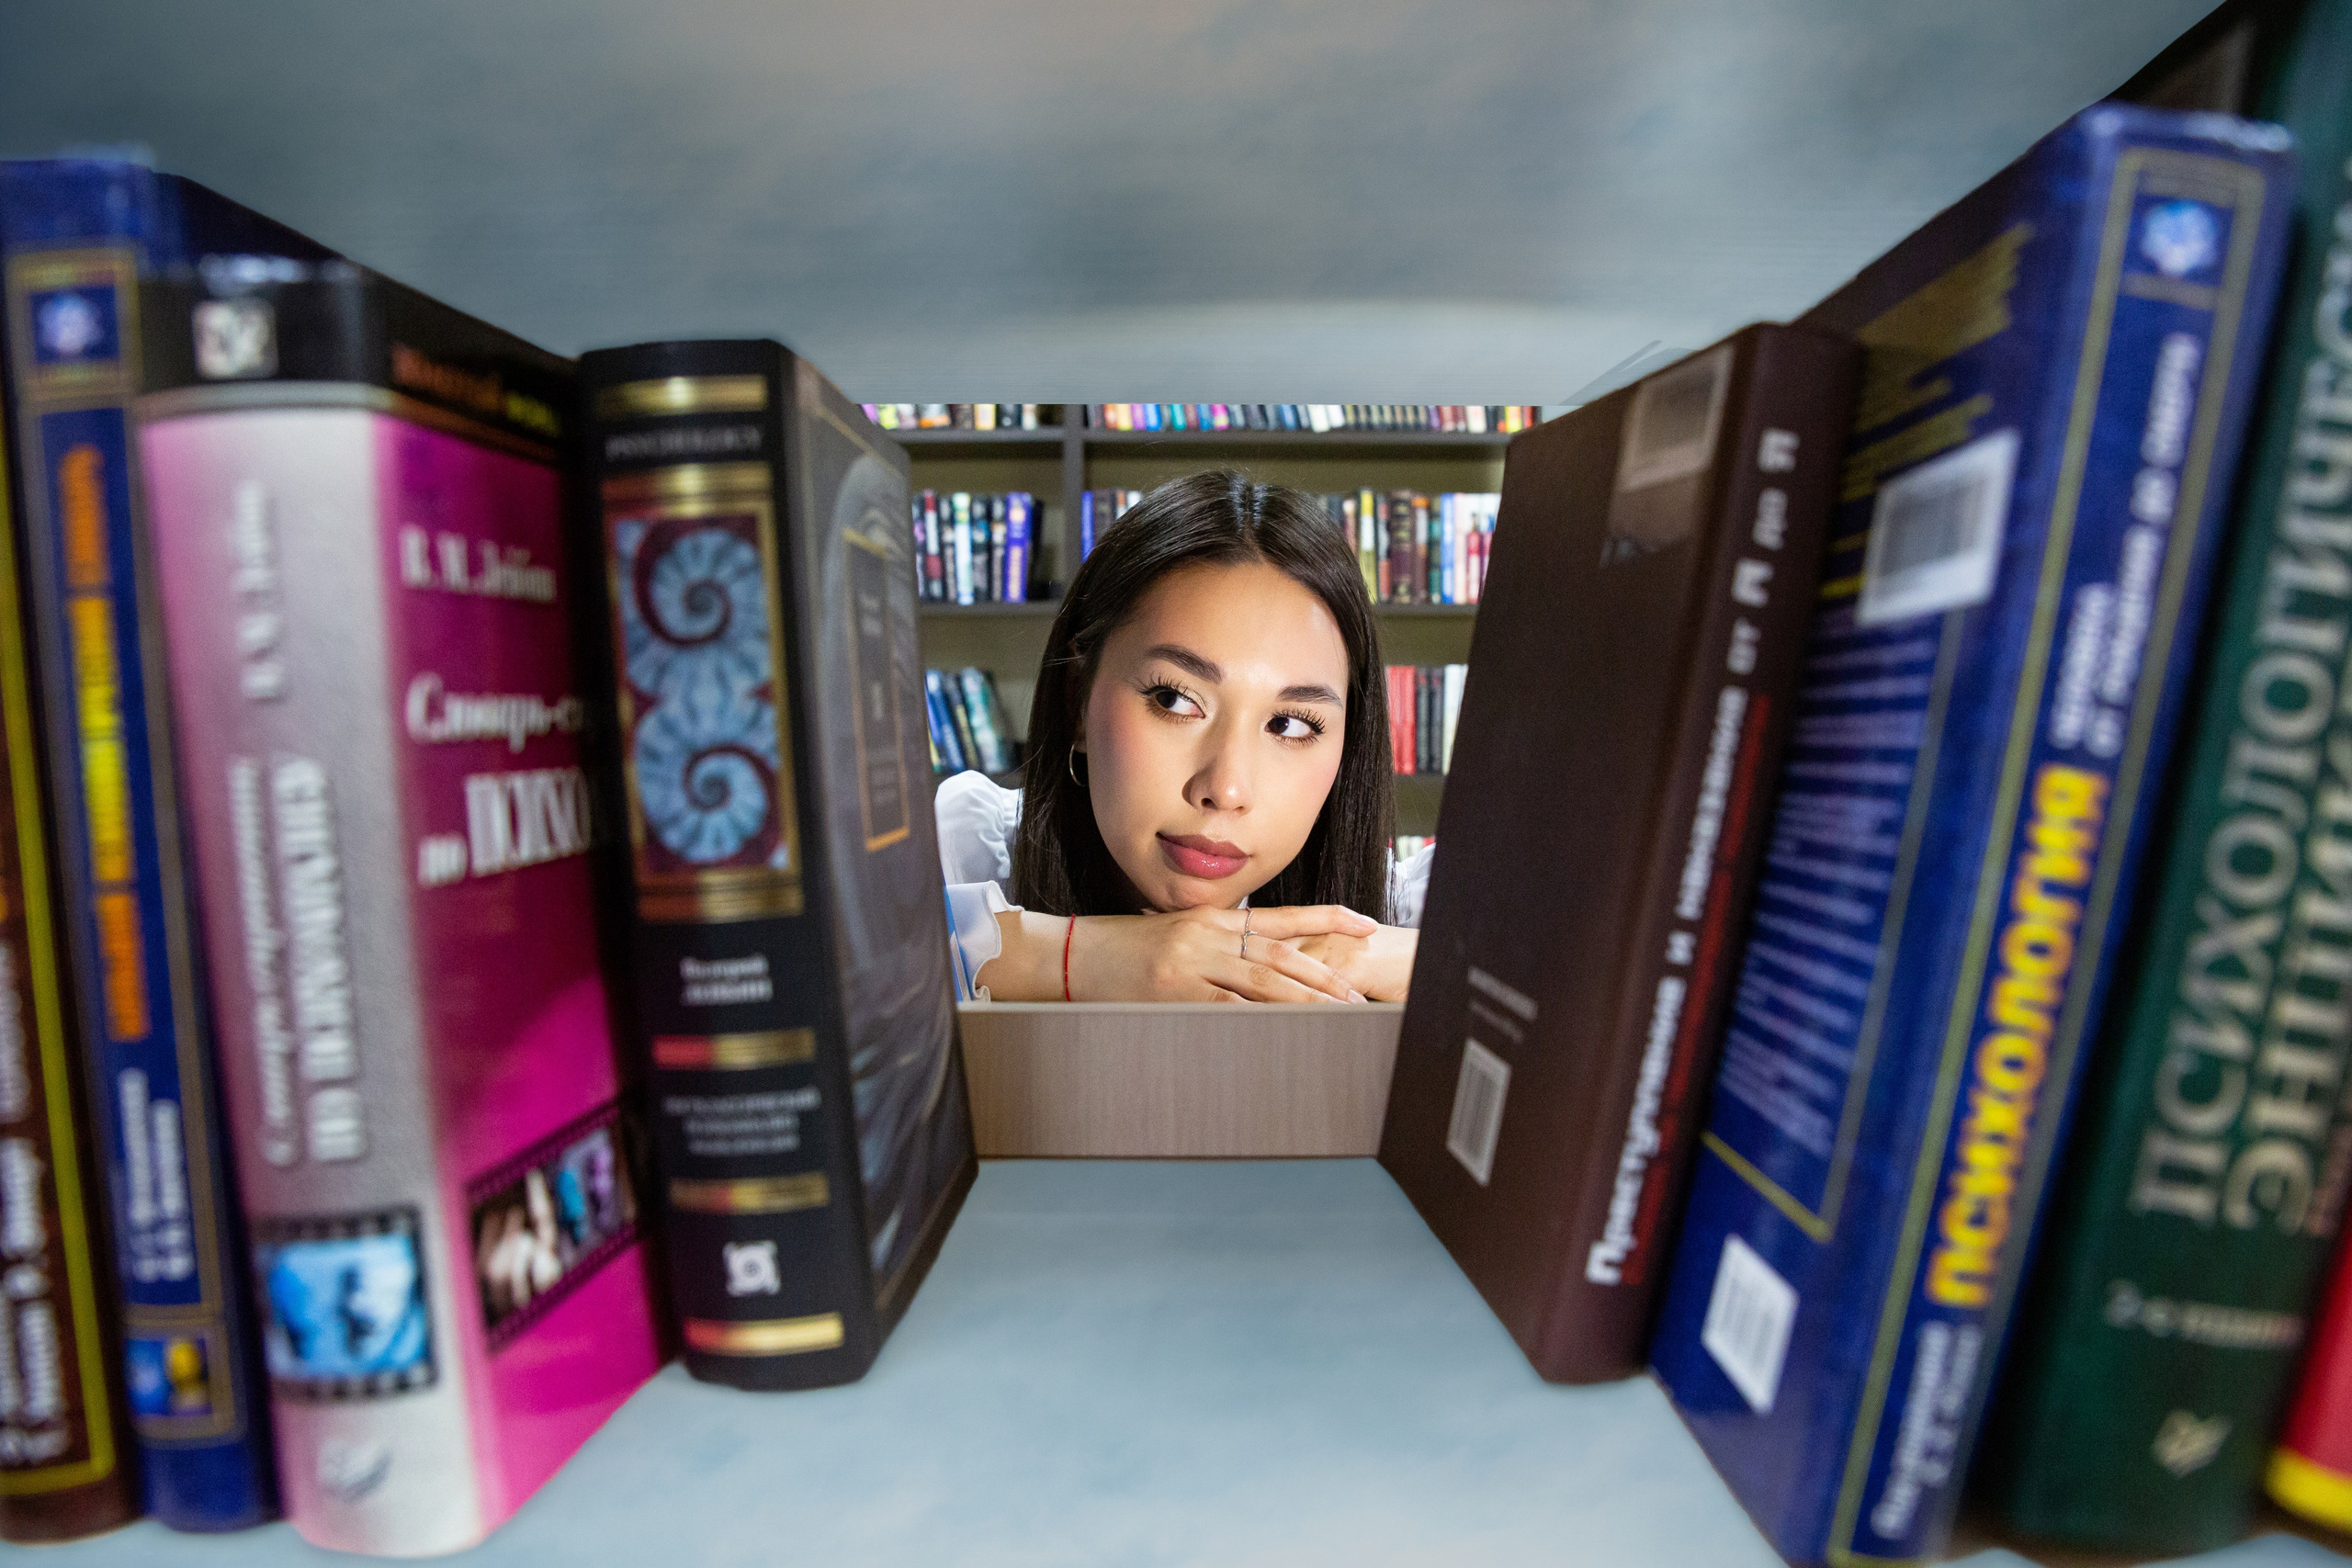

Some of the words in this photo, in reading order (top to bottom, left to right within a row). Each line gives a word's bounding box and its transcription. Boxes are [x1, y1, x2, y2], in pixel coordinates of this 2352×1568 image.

[1758, 427, 1800, 473] Я
[1751, 487, 1789, 551] до
[1726, 616, 1761, 676] от
[1675, 685, 1748, 919] наказание
[1666, 931, 1697, 966] и
[1925, 765, 2109, 1309] ПСИХОЛОГИЯ
[1586, 976, 1687, 1286] Преступление
